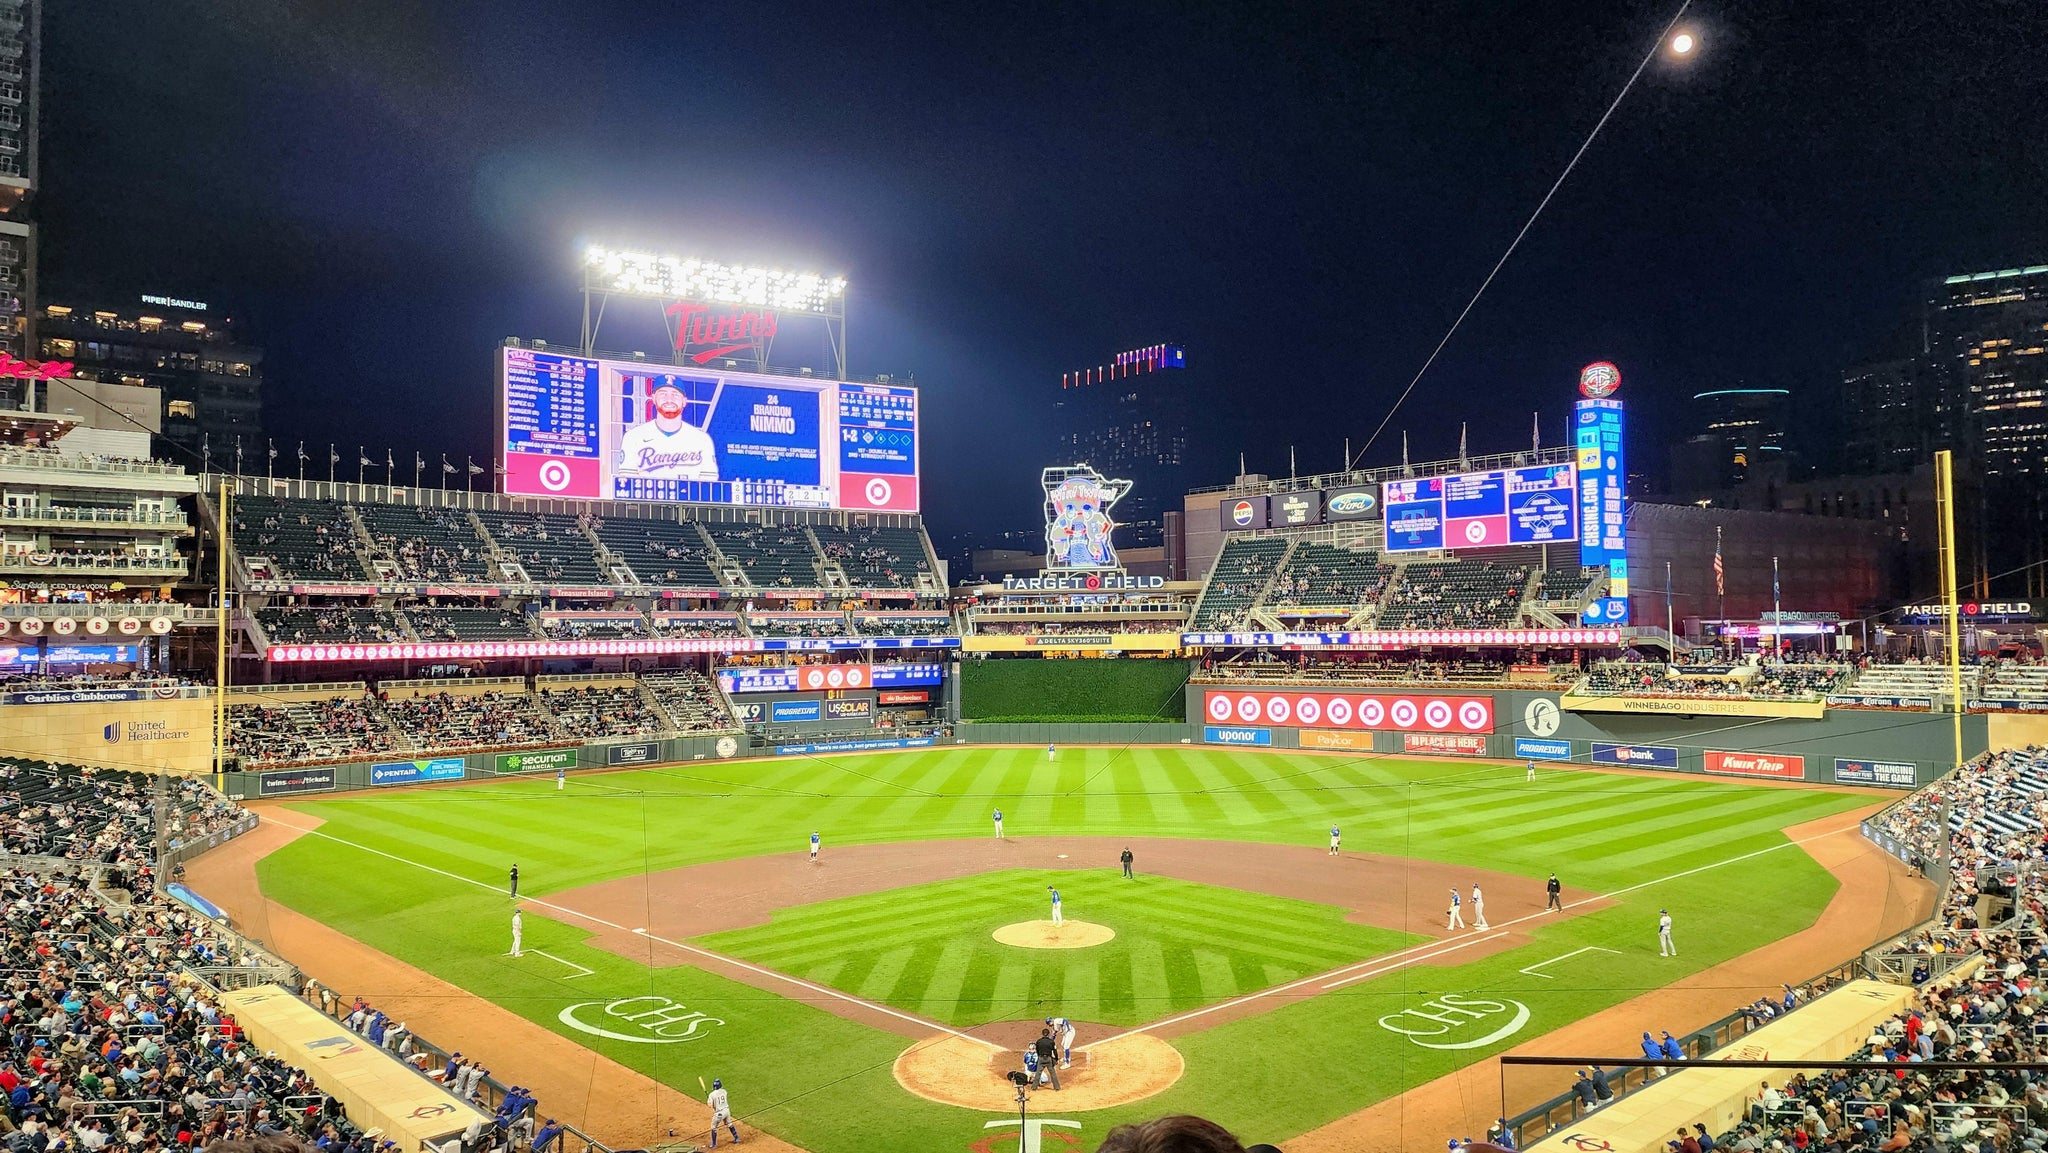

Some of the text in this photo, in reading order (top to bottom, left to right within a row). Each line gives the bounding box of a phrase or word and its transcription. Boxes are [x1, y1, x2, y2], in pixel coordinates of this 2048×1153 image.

[142, 295, 207, 310] PIPER SANDLER
[666, 304, 777, 351] Twins
[664, 374, 676, 384] T
[767, 394, 778, 405] 24
[754, 404, 792, 417] BRANDON
[750, 415, 795, 434] NIMMO
[842, 429, 858, 442] 1-2
[638, 447, 702, 468] Rangers
[635, 479, 641, 488] 2
[789, 491, 794, 499] 2
[804, 491, 809, 499] 2
[1338, 499, 1365, 510] Ford
[11, 580, 48, 590] Surfside
[1003, 576, 1164, 589] TARGET FIELD
[303, 586, 341, 594] Treasure
[1982, 603, 2031, 613] FIELD
[1802, 612, 1840, 621] INDUSTRIES
[25, 692, 127, 702] Carbliss Clubhouse
[1624, 701, 1745, 712] WINNEBAGO INDUSTRIES
[1900, 699, 1930, 707] Corona
[1969, 700, 2002, 709] Corona
[2018, 702, 2048, 710] Corona
[751, 705, 760, 716] 9
[775, 707, 818, 716] PROGRESSIVE
[128, 720, 166, 730] United
[128, 730, 190, 741] Healthcare
[1219, 730, 1256, 742] uponor
[1318, 735, 1352, 746] Paycor
[1420, 736, 1444, 746] PLACE
[1458, 738, 1478, 748] HERE
[1518, 744, 1568, 754] PROGRESSIVE
[522, 753, 567, 765] securian
[1723, 756, 1784, 771] KWIK TRIP
[1874, 764, 1914, 775] CHANGING
[267, 776, 330, 787] twins.com/tickets
[1875, 773, 1913, 783] THE GAME
[604, 996, 725, 1037] CHS
[1378, 994, 1506, 1036] CHS
